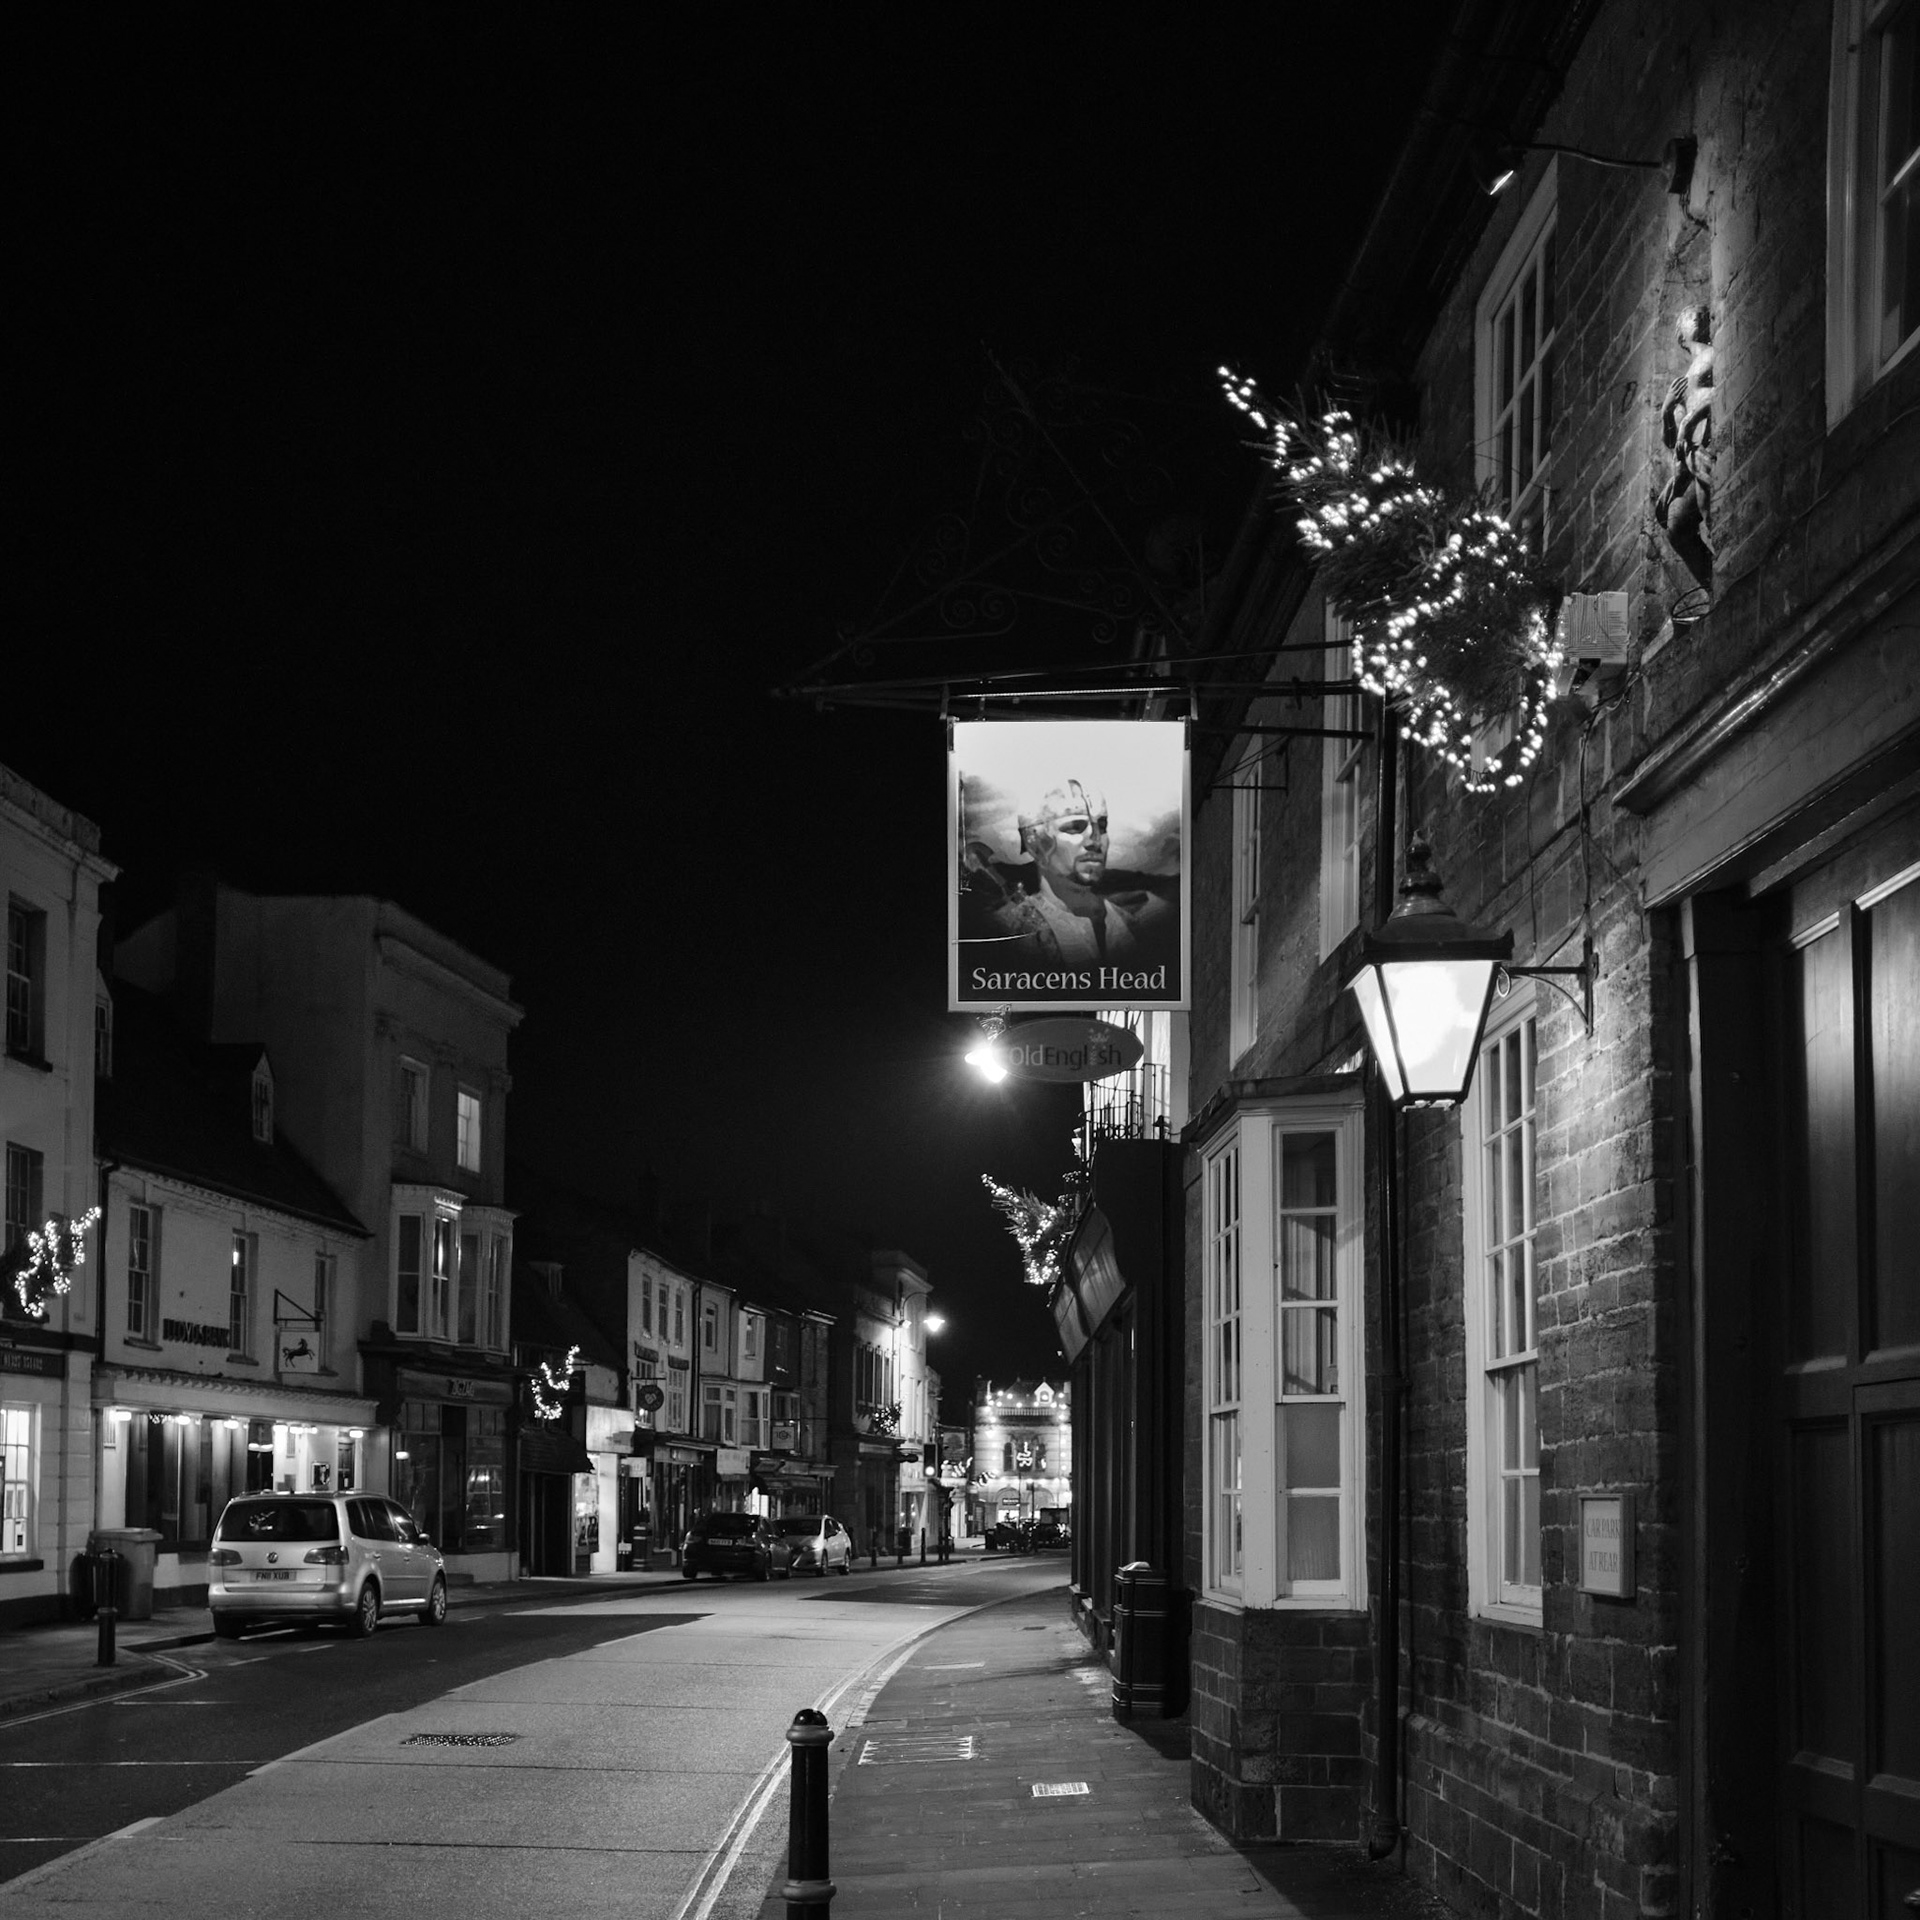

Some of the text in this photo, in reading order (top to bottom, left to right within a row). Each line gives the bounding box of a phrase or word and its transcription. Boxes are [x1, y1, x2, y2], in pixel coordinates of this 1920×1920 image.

[972, 964, 1166, 990] Saracens Head
[1586, 1517, 1620, 1540] CAR PARK
[1588, 1550, 1618, 1574] AT REAR
